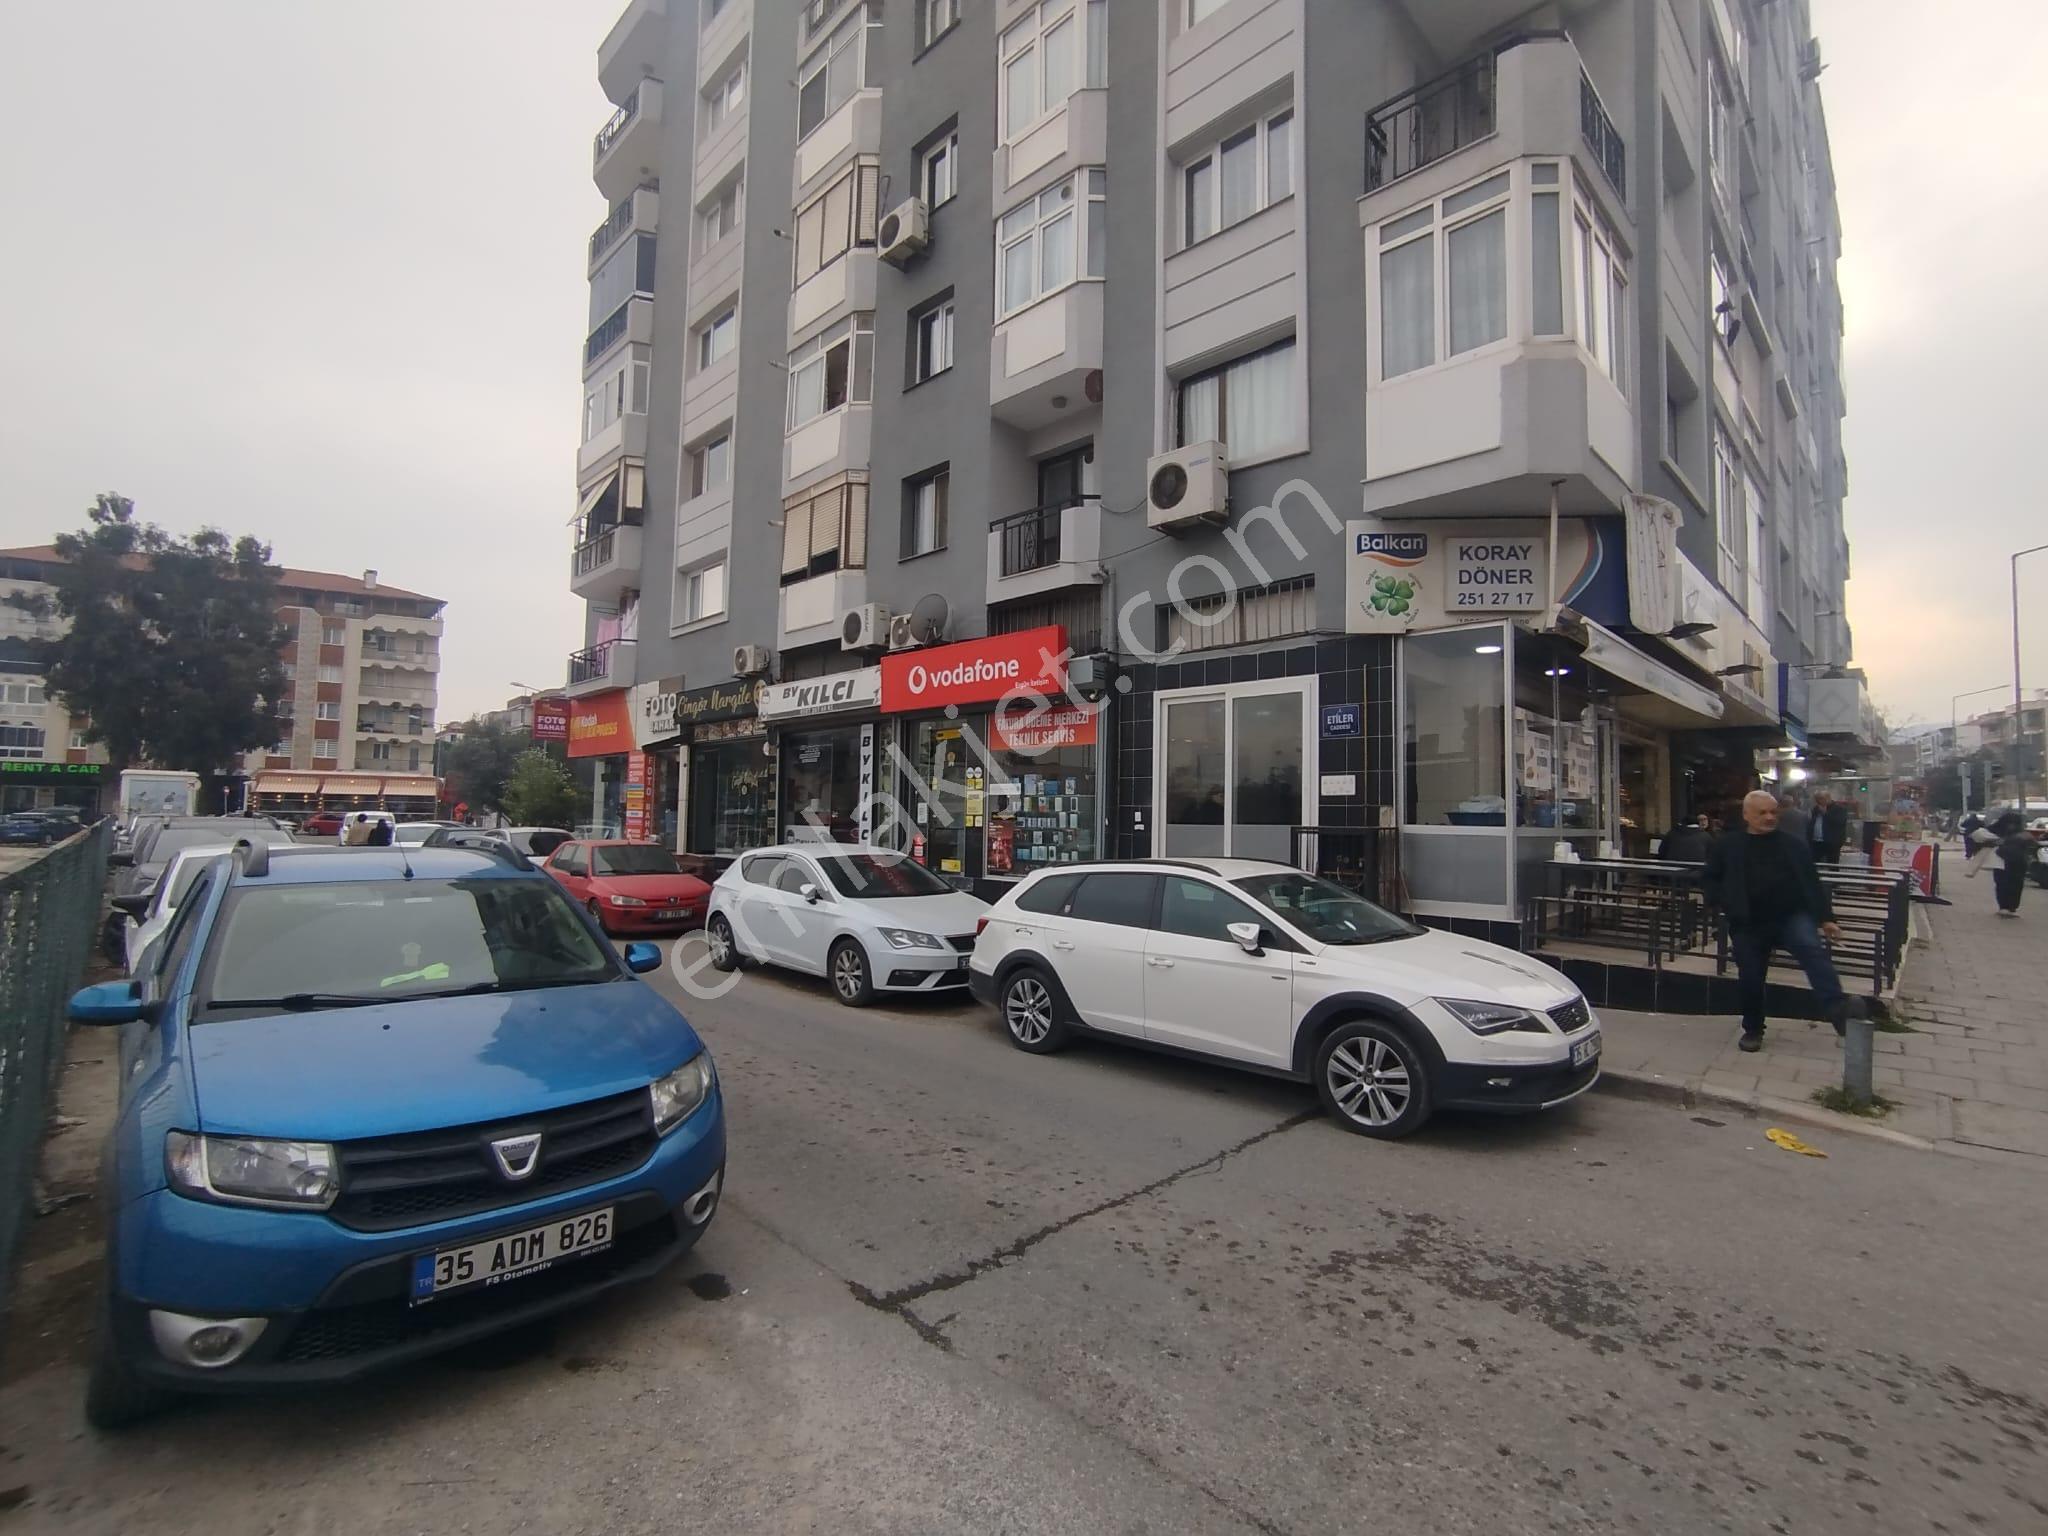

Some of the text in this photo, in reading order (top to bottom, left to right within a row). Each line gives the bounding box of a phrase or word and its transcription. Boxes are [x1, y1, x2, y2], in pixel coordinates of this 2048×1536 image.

[1360, 534, 1424, 550] Balkan
[1459, 545, 1532, 561] KORAY
[1458, 566, 1533, 585] DÖNER
[1458, 592, 1534, 605] 251 27 17
[930, 658, 1019, 688] vodafone
[711, 683, 751, 712] Nargile
[783, 680, 855, 707] BY KILCI
[646, 693, 677, 716] FOTO
[537, 716, 566, 724] FOTO
[1327, 712, 1353, 725] ETİLER
[1009, 726, 1075, 746] TEKNİK SERVİS
[2, 763, 100, 774] RENT A CAR
[436, 1213, 608, 1286] 35 ADM 826
[503, 1261, 553, 1281] Otomotiv
[419, 1277, 433, 1289] TR
